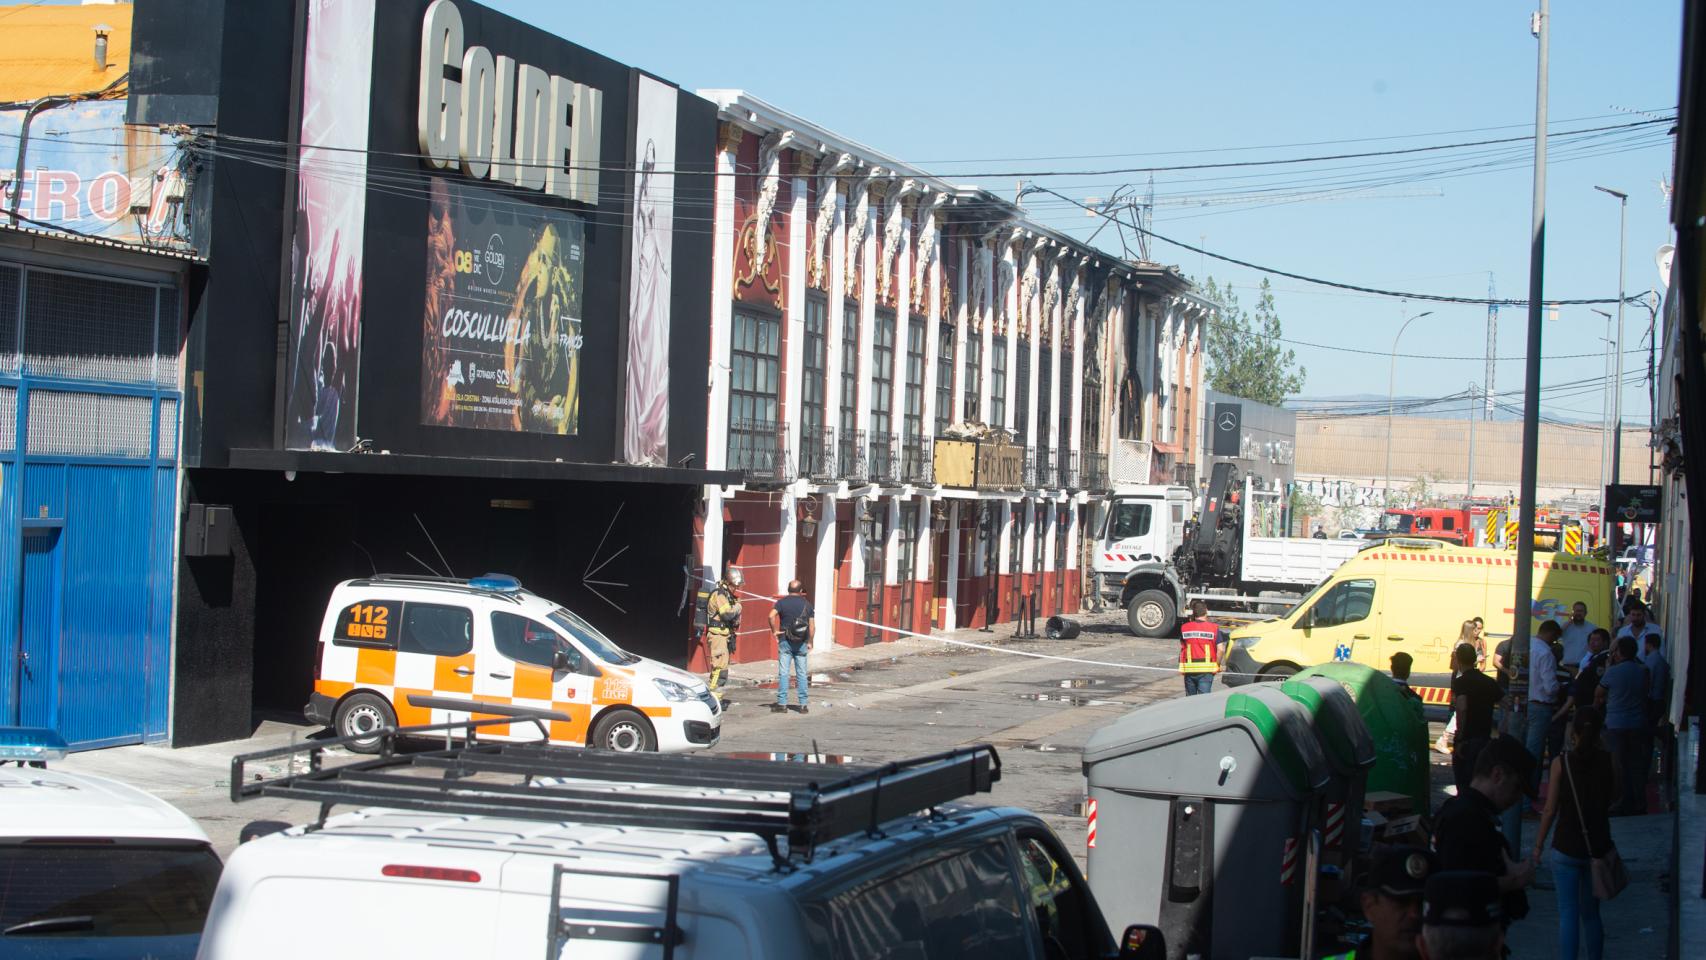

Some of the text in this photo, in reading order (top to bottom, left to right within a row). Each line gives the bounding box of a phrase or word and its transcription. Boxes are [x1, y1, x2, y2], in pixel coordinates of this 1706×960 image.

[418, 0, 603, 206] GOLDEN
[455, 249, 473, 274] 08
[473, 263, 482, 275] DIC
[484, 250, 505, 268] GOLDEN
[442, 306, 531, 347] COSCULLUELA
[496, 368, 511, 386] SCS
[350, 604, 389, 624] 112
